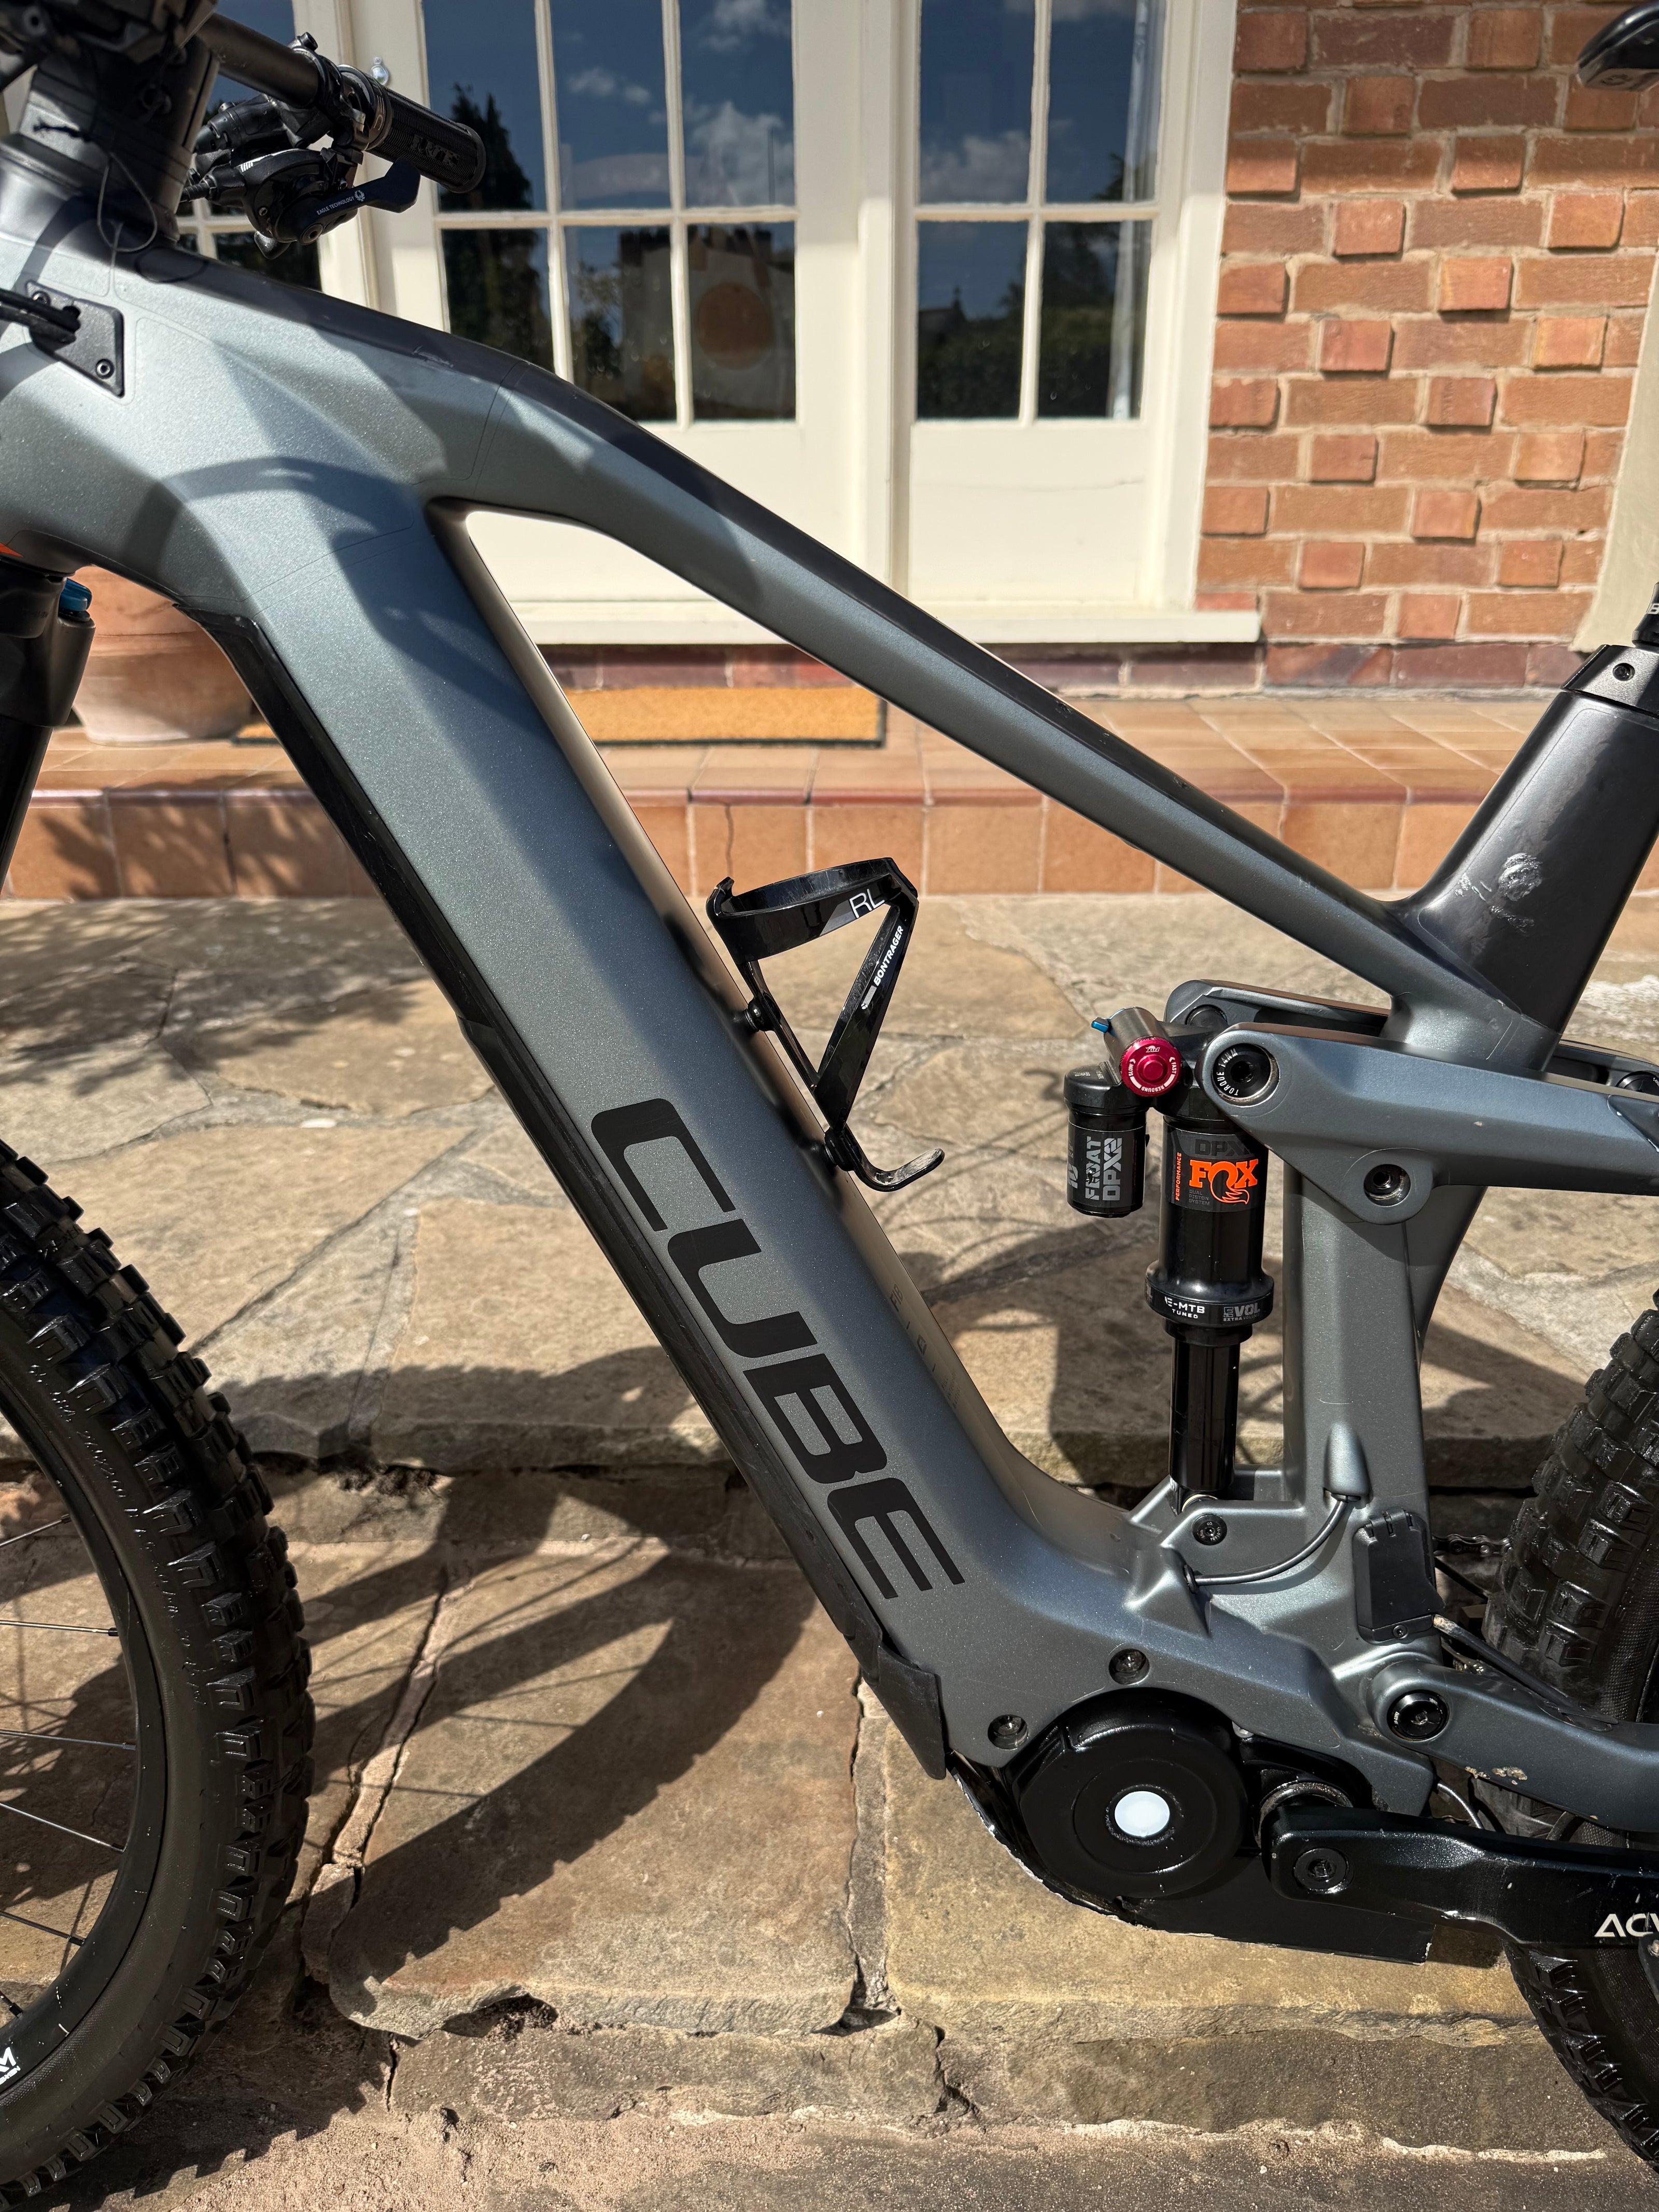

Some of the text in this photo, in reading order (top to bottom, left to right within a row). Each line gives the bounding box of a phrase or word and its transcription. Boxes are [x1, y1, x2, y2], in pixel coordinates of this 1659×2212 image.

[316, 196, 355, 215] EAGLE TECHNOLOGY
[849, 889, 885, 918] RL
[874, 925, 904, 987] BONTRAGER
[1216, 1072, 1239, 1095] TORQUE
[1085, 1136, 1101, 1200] FLOAT
[1103, 1138, 1122, 1201] DPX2
[1189, 1159, 1259, 1199] FOX
[1164, 1296, 1205, 1314] E-MTB
[1172, 1308, 1199, 1319] TUNED
[591, 1098, 965, 1599] CUBE
